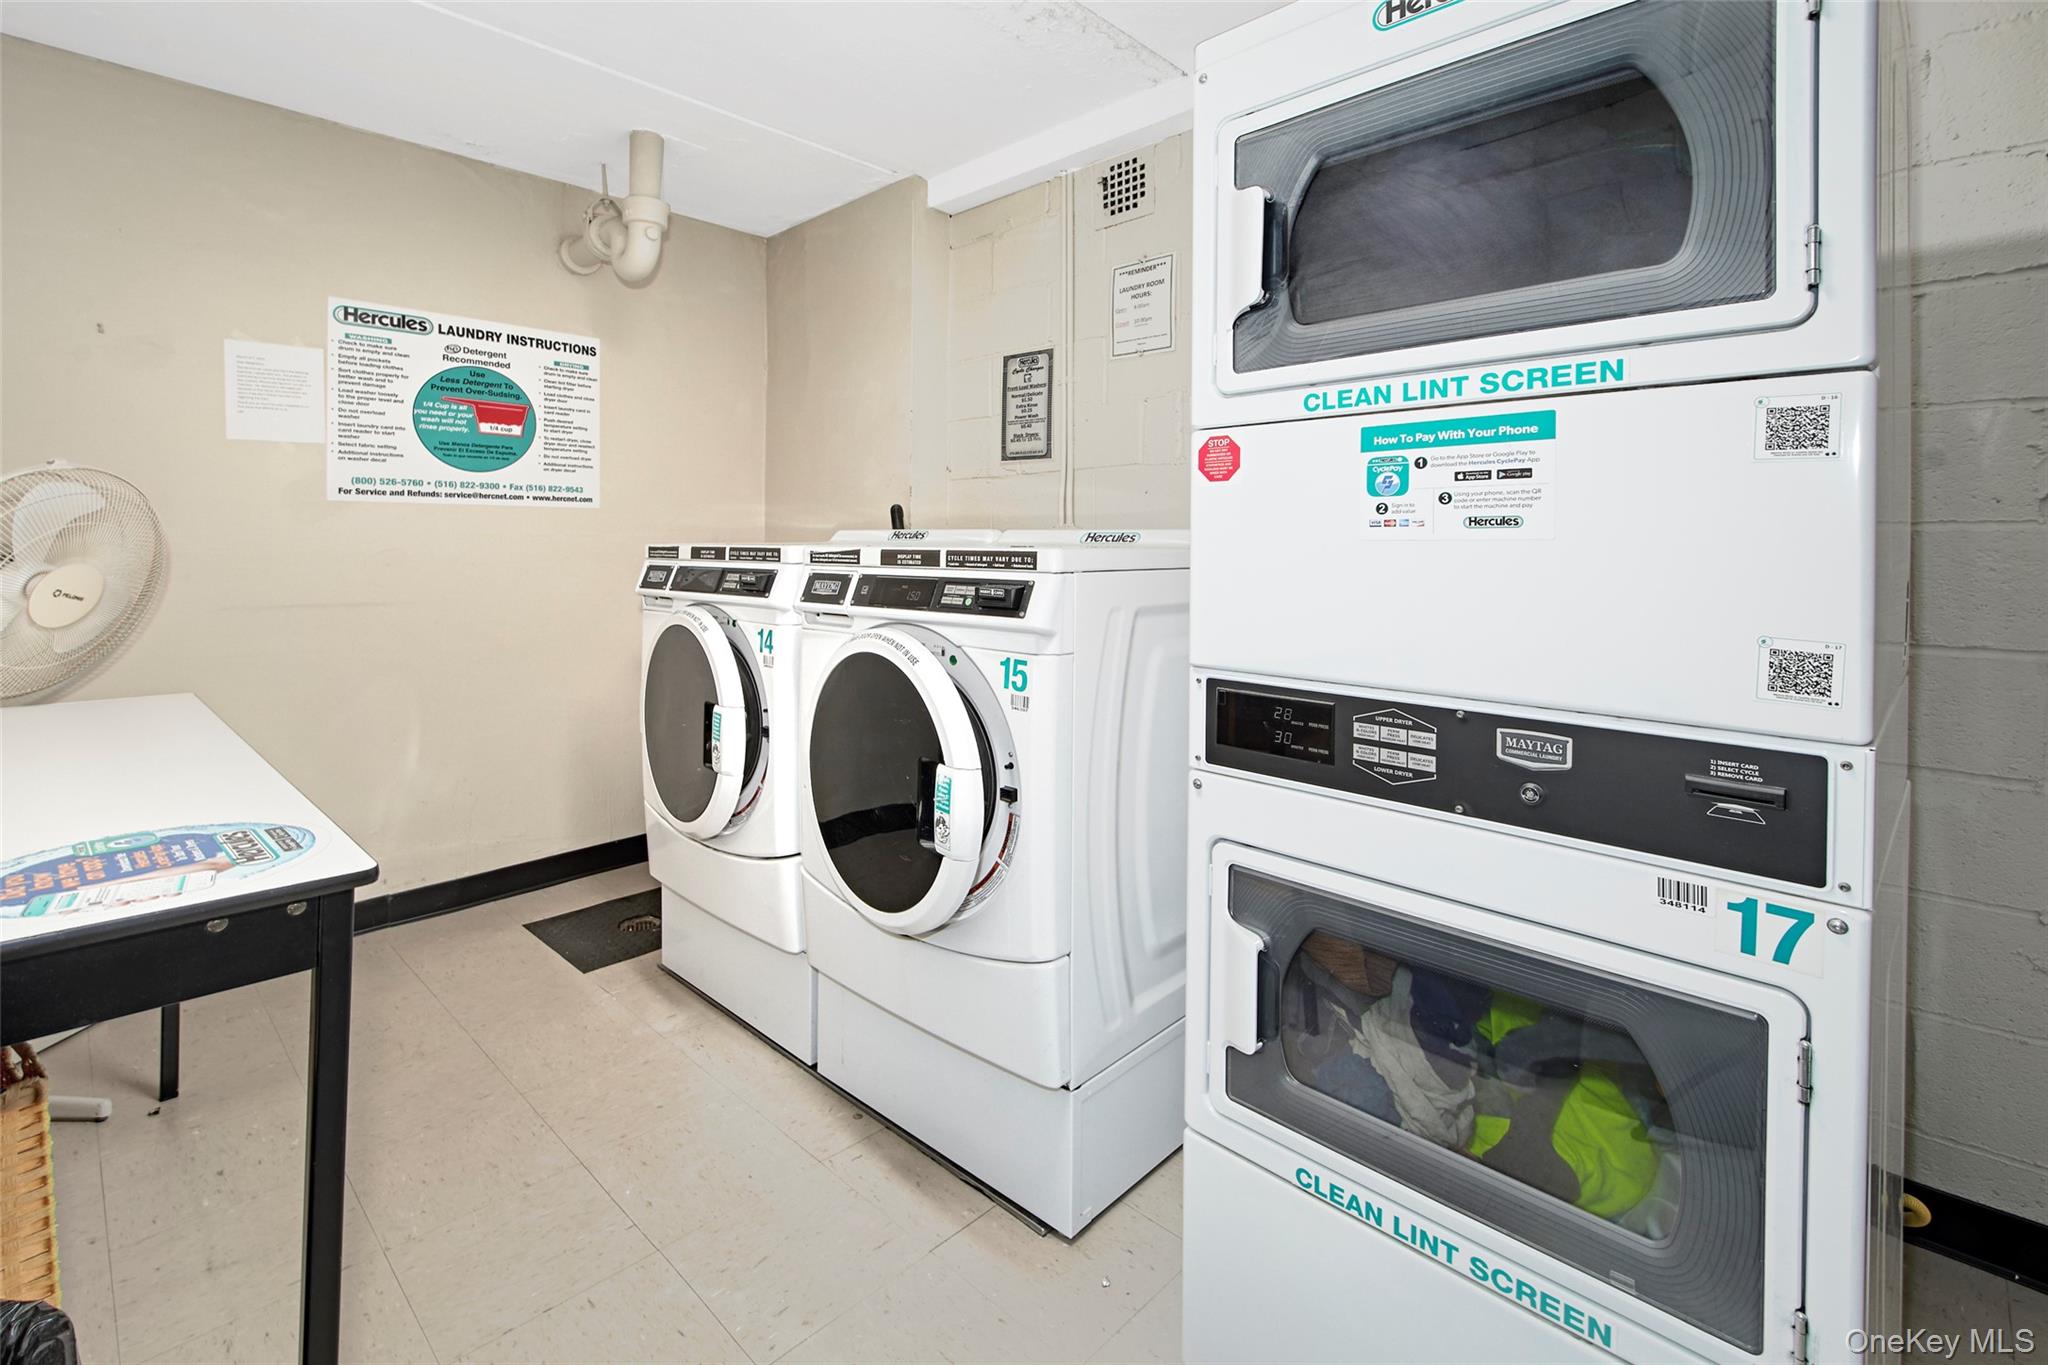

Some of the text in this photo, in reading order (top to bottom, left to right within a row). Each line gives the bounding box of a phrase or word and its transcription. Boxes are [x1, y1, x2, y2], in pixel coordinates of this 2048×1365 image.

[1119, 279, 1165, 294] LAUNDRY ROOM
[1131, 291, 1152, 299] HOURS:
[343, 306, 427, 331] Hercules
[438, 324, 597, 356] LAUNDRY INSTRUCTIONS
[462, 346, 507, 359] Detergent
[442, 354, 511, 369] Recommended
[440, 376, 461, 385] Less
[462, 378, 502, 389] Detergent
[1303, 359, 1625, 412] CLEAN LINT SCREEN
[430, 384, 522, 400] Prevent Over-Sudsing.
[1374, 425, 1538, 446] How To Pay With Your Phone
[1208, 439, 1229, 448] STOP
[351, 477, 584, 494] (800) 526-5760 (516) 822-9300 Fax (516) 822-9543
[355, 488, 387, 496] Service
[390, 489, 404, 497] and
[407, 490, 442, 498] Refunds:
[444, 492, 524, 501] service@hercnet.com
[532, 494, 593, 503] www.hercnet.com
[1468, 516, 1519, 526] Hercules
[891, 531, 926, 539] Hercules
[1085, 532, 1136, 542] Hercules
[814, 581, 839, 590] MAYTAG
[758, 629, 773, 654] 14
[907, 655, 919, 666] USE
[1000, 657, 1028, 692] 15
[1274, 707, 1292, 720] 28
[1275, 731, 1292, 744] 30
[1505, 748, 1537, 758] COMMERCIAL
[1506, 737, 1562, 754] MAYTAG
[1659, 899, 1706, 913] 348114
[1727, 897, 1815, 965] 17
[1295, 1167, 1612, 1349] CLEAN LINT SCREEN
